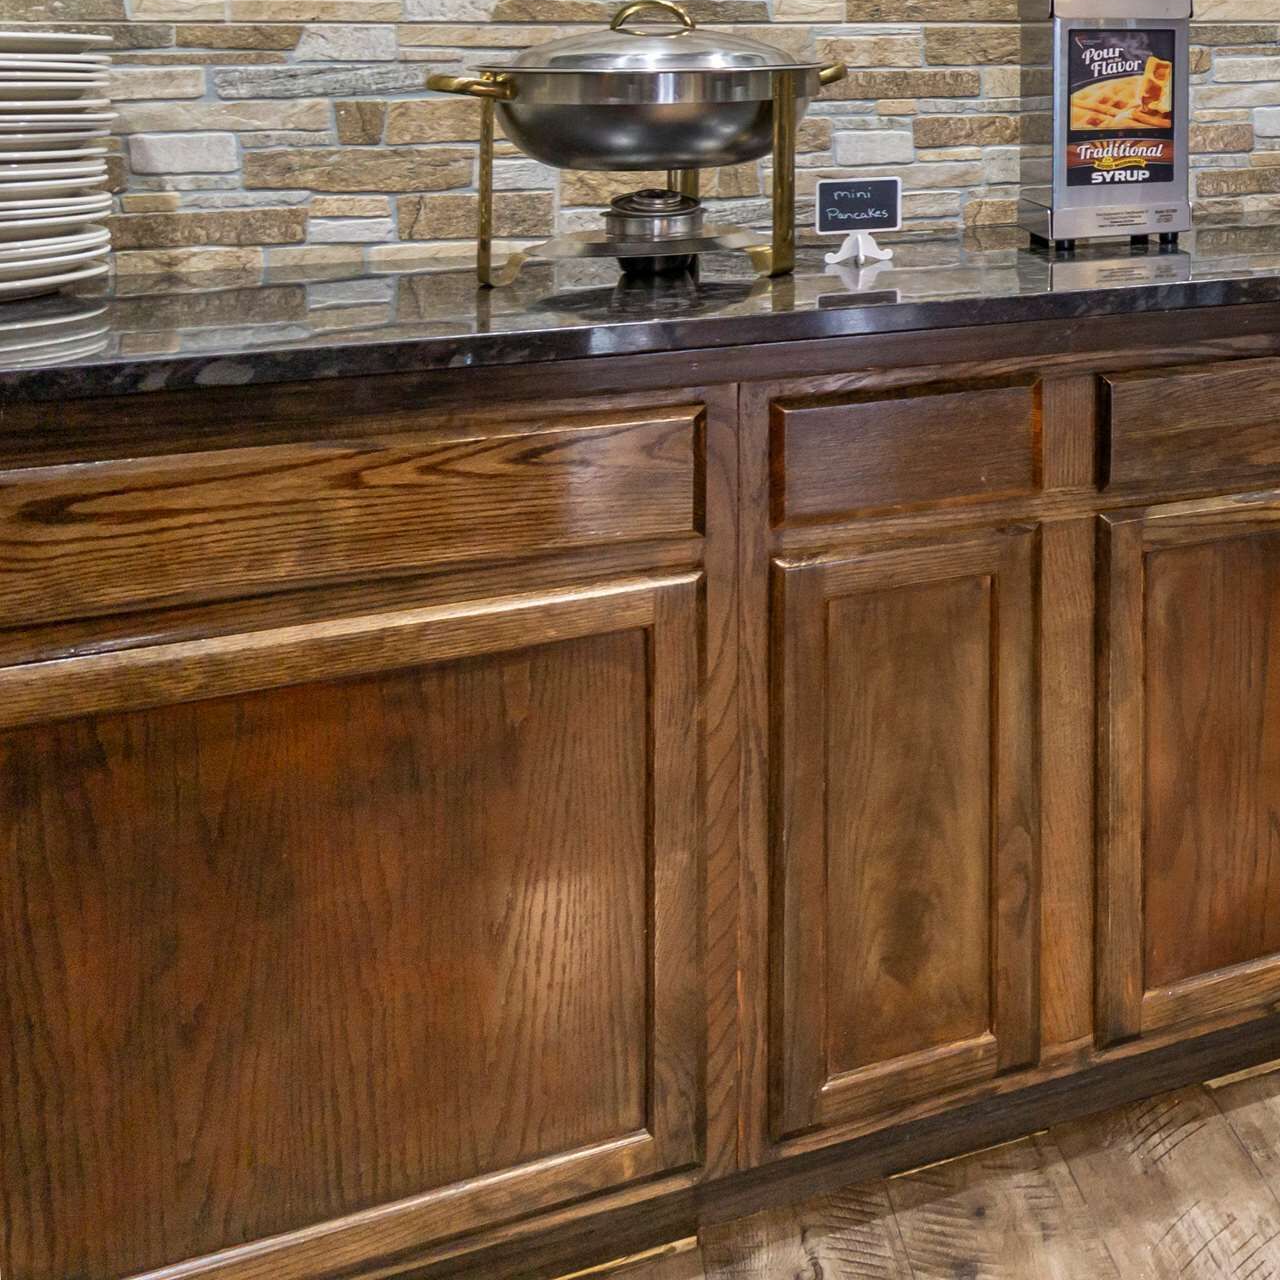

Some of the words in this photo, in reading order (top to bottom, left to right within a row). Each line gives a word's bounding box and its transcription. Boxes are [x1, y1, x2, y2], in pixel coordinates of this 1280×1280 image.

[1082, 47, 1124, 64] Pour
[1091, 60, 1142, 77] Flavor
[1077, 144, 1164, 160] Traditional
[1091, 169, 1150, 183] SYRUP
[833, 186, 871, 200] mini
